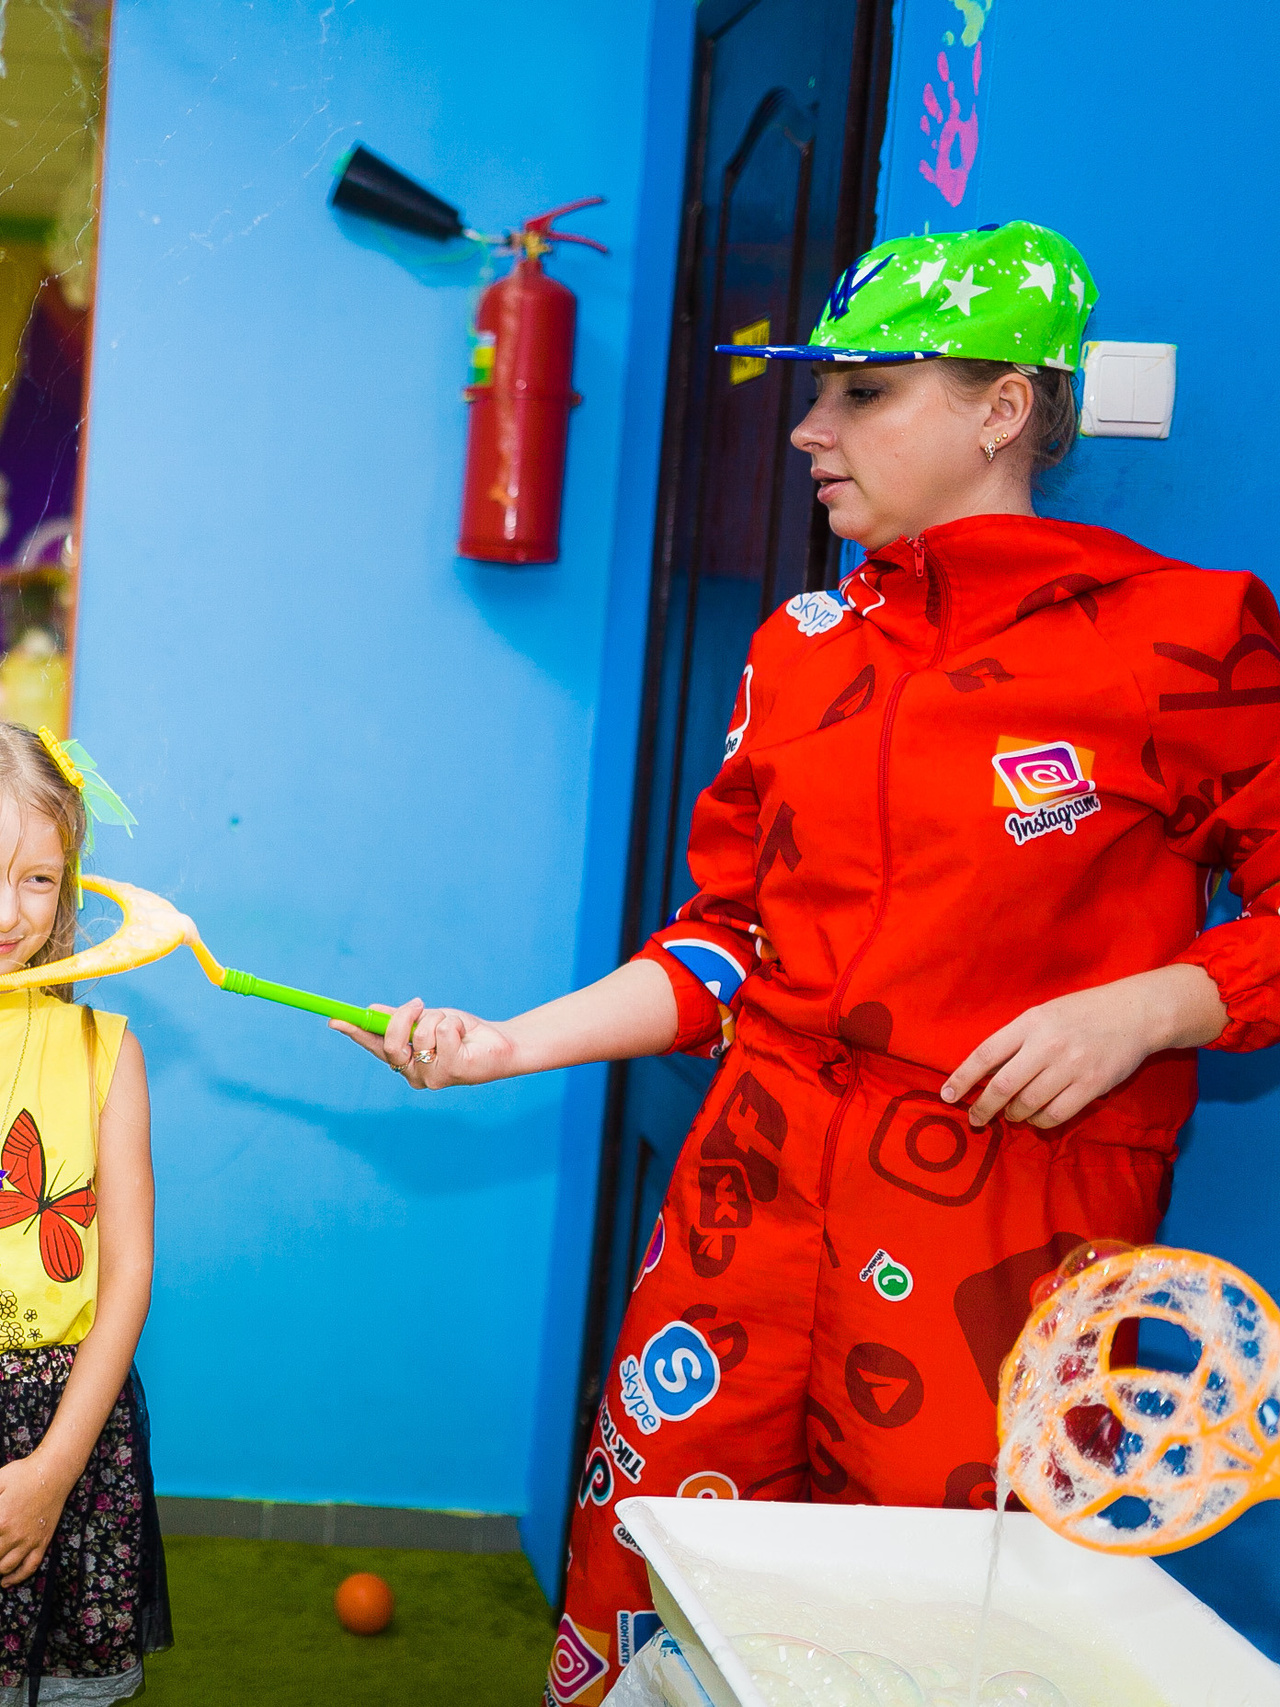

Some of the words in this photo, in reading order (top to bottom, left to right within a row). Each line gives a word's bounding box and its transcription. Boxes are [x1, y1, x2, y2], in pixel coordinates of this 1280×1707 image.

[1008, 795, 1100, 842] Instagram
[861, 1250, 885, 1280] WhatsApp
[620, 1613, 630, 1664] ВКОНТАКТЕ
